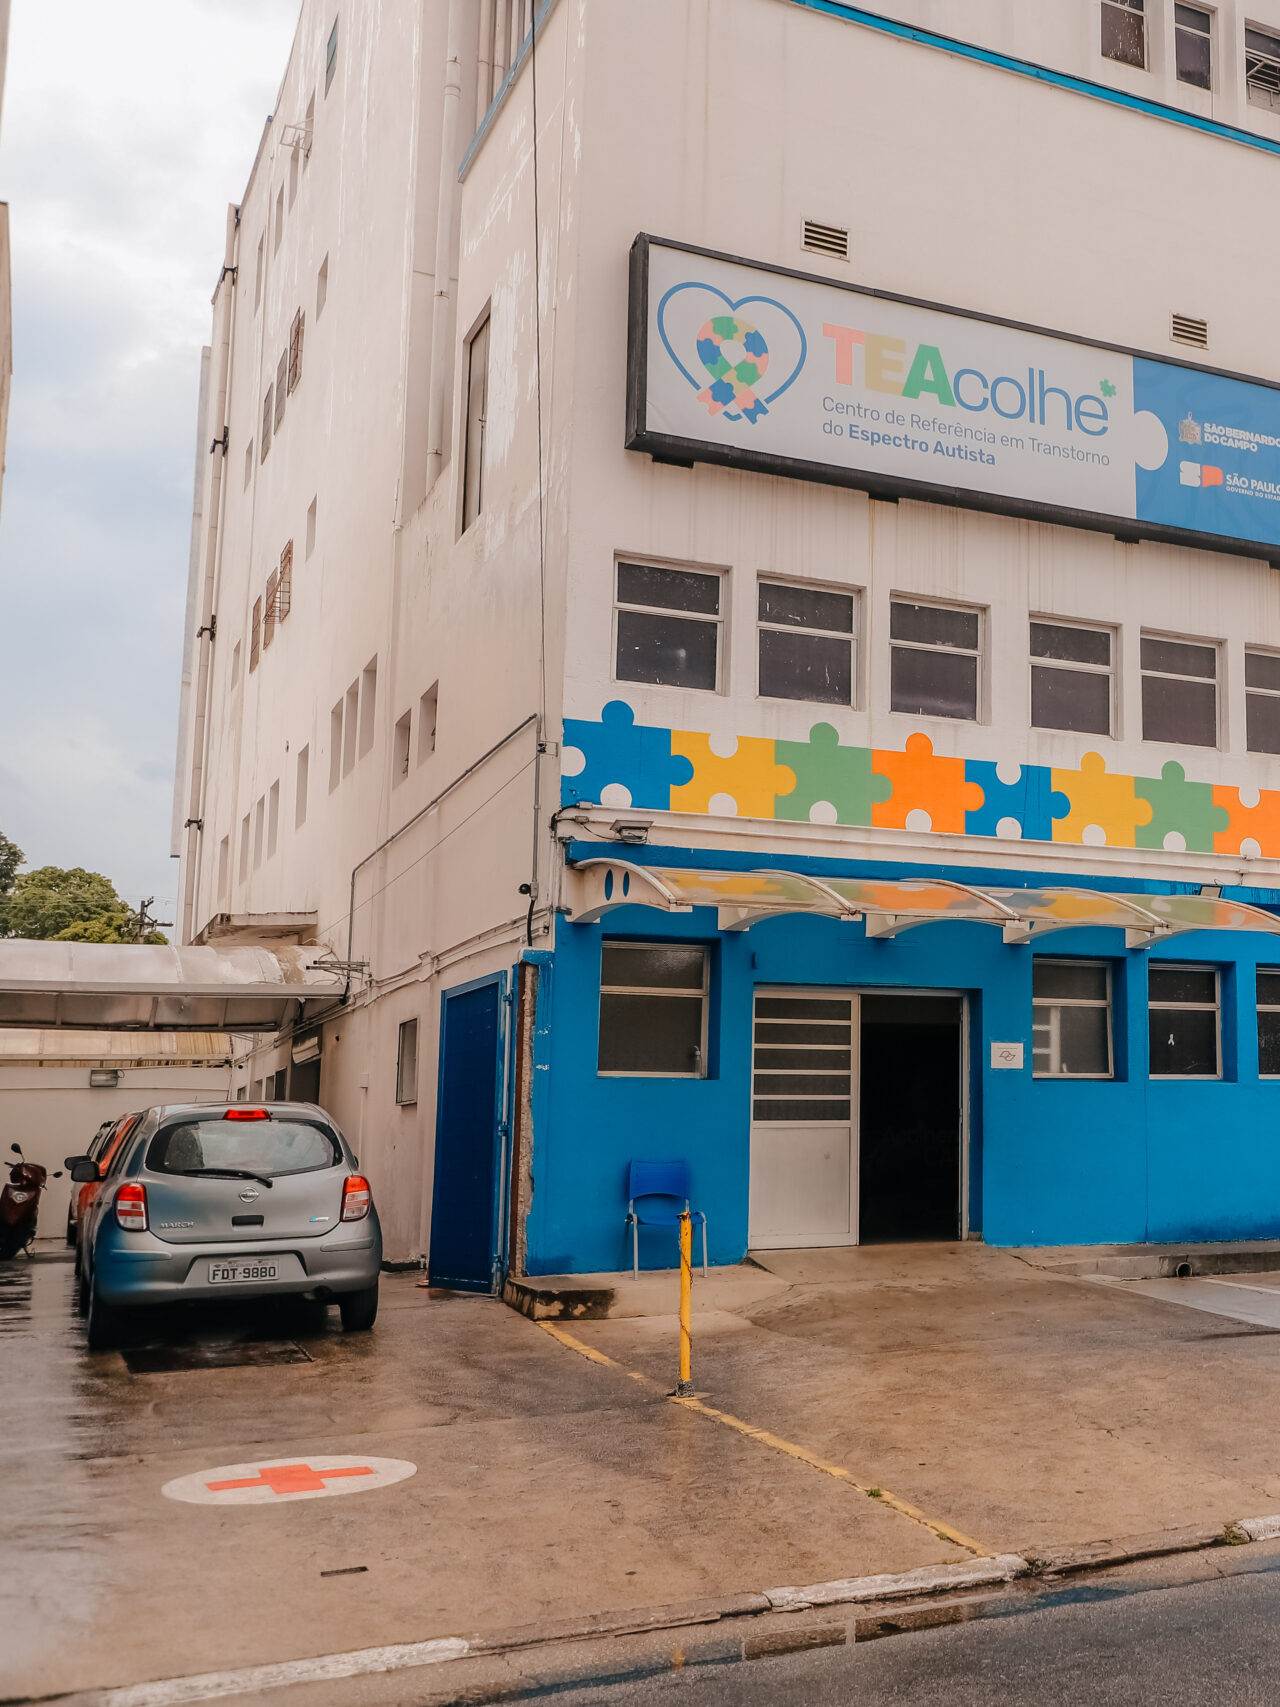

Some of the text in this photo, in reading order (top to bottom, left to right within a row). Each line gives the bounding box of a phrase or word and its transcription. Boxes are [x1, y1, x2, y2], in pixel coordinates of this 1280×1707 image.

[822, 322, 1109, 436] TEAcolhe
[822, 396, 1110, 466] Centro de Referência em Transtorno
[822, 420, 996, 465] do Espectro Autista
[1204, 433, 1258, 452] DO CAMPO
[1226, 473, 1249, 488] SÃO
[1226, 487, 1253, 496] GOVERNO
